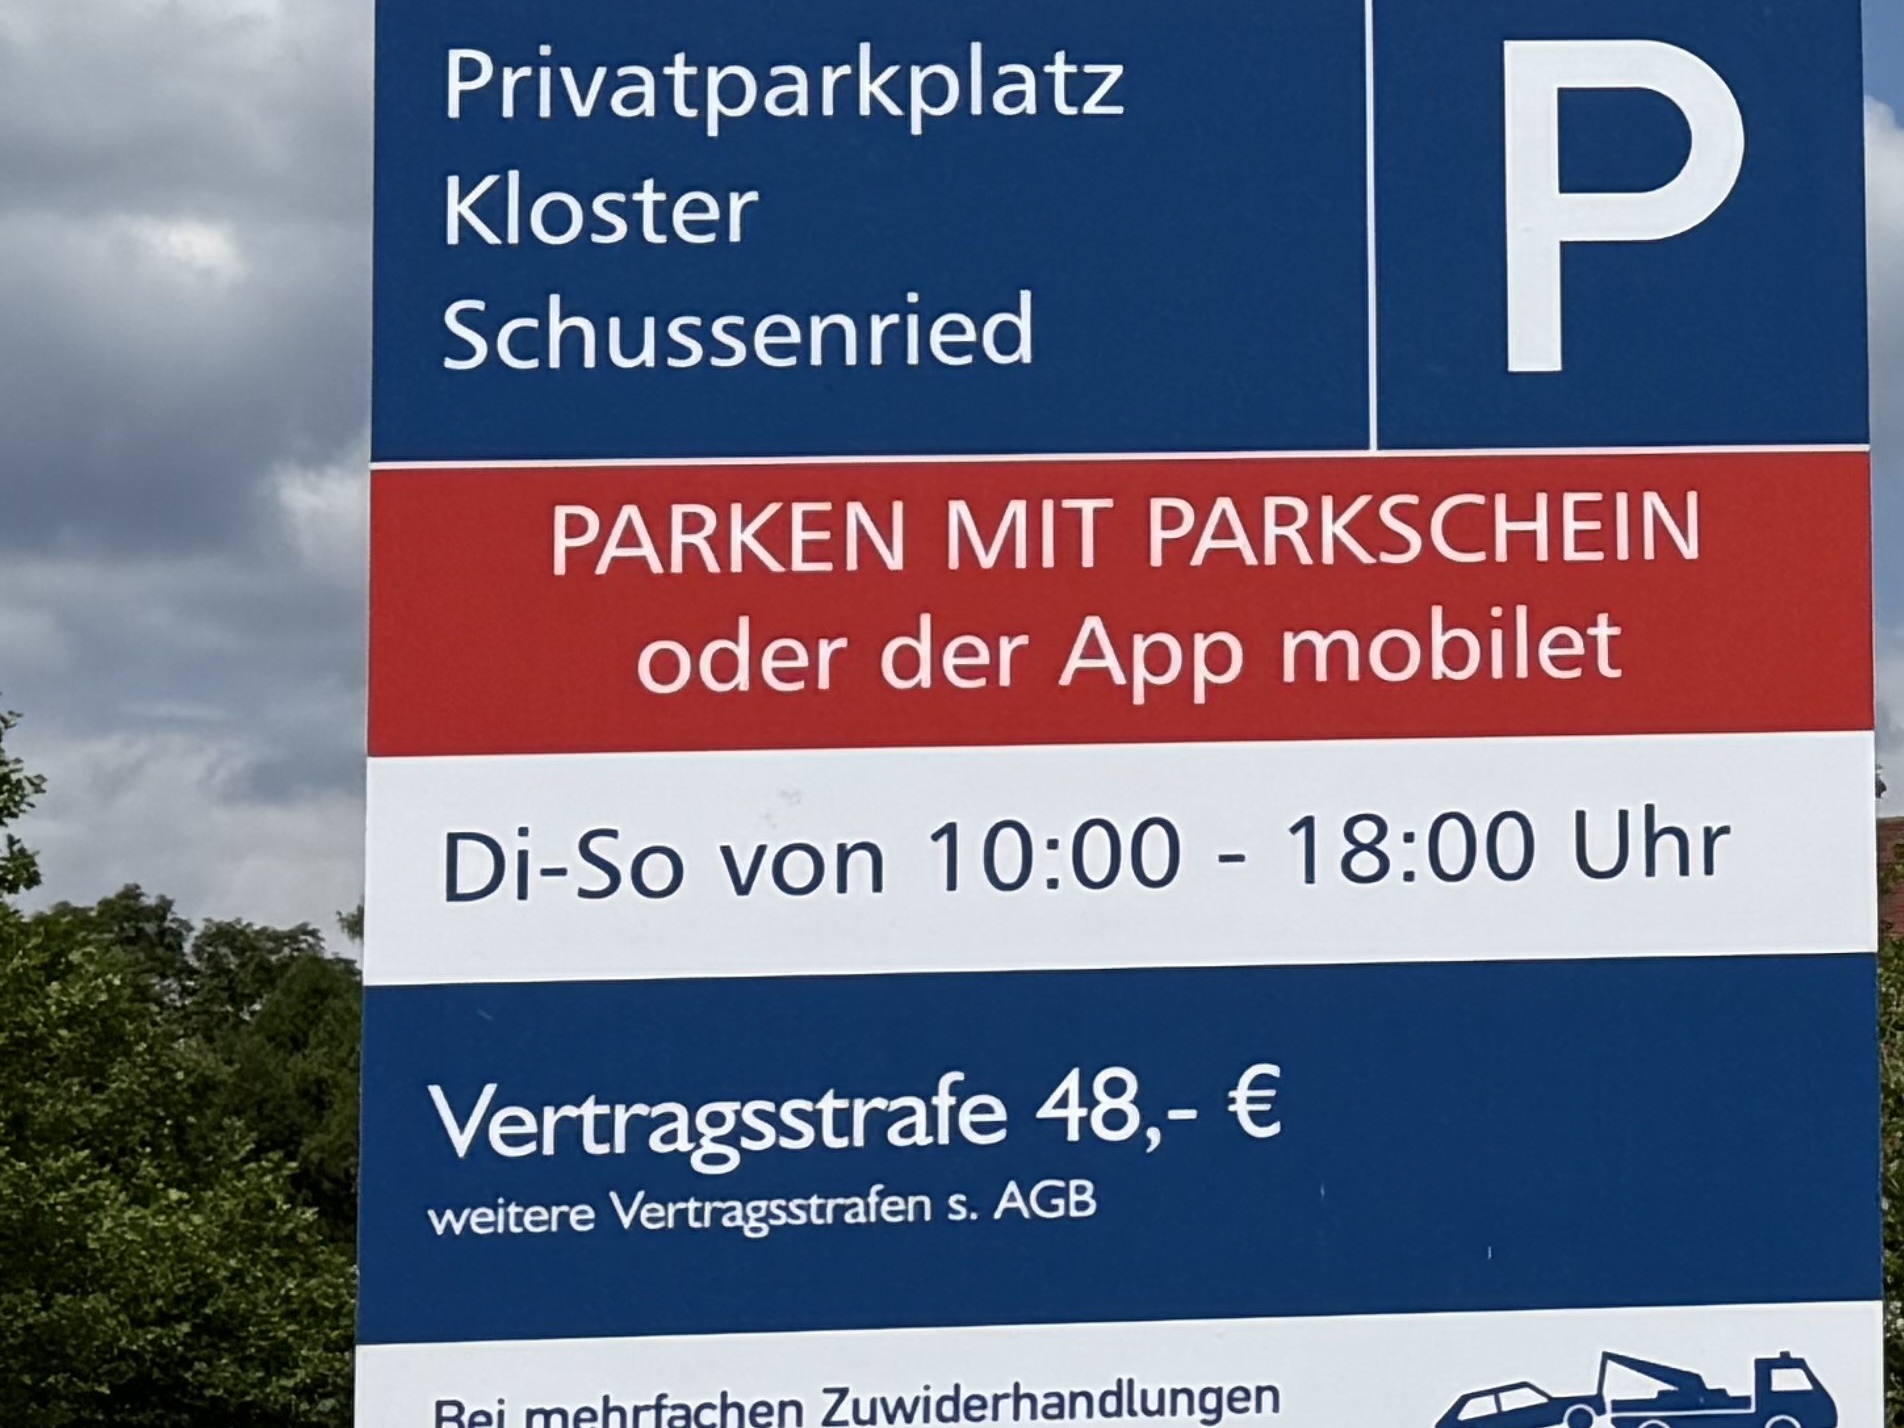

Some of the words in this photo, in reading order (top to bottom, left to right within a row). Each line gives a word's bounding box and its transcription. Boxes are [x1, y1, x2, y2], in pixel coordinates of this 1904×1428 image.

[447, 41, 1124, 137] Privatparkplatz
[446, 169, 759, 245] Kloster
[1503, 39, 1745, 372] P
[443, 289, 1032, 370] Schussenried
[553, 500, 904, 576] PARKEN
[948, 498, 1114, 570] MIT
[1150, 490, 1699, 567] PARKSCHEIN
[637, 615, 848, 694] oder
[881, 612, 1029, 690] der
[1058, 615, 1244, 706] App
[1283, 604, 1622, 683] mobilet
[445, 826, 684, 903] Di-So
[719, 841, 883, 897] von
[930, 816, 1181, 892] 10:00
[1289, 810, 1535, 885] 18:00
[1575, 803, 1731, 880] Uhr
[427, 1070, 1008, 1175] Vertragsstrafe
[1035, 1066, 1198, 1153] 48,-
[1227, 1063, 1281, 1138] €
[427, 1197, 596, 1236] weitere
[609, 1183, 932, 1239] Vertragsstrafen
[947, 1193, 978, 1221] s.
[993, 1178, 1097, 1220] AGB
[820, 1377, 1280, 1428] Zuwiderhandlungen
